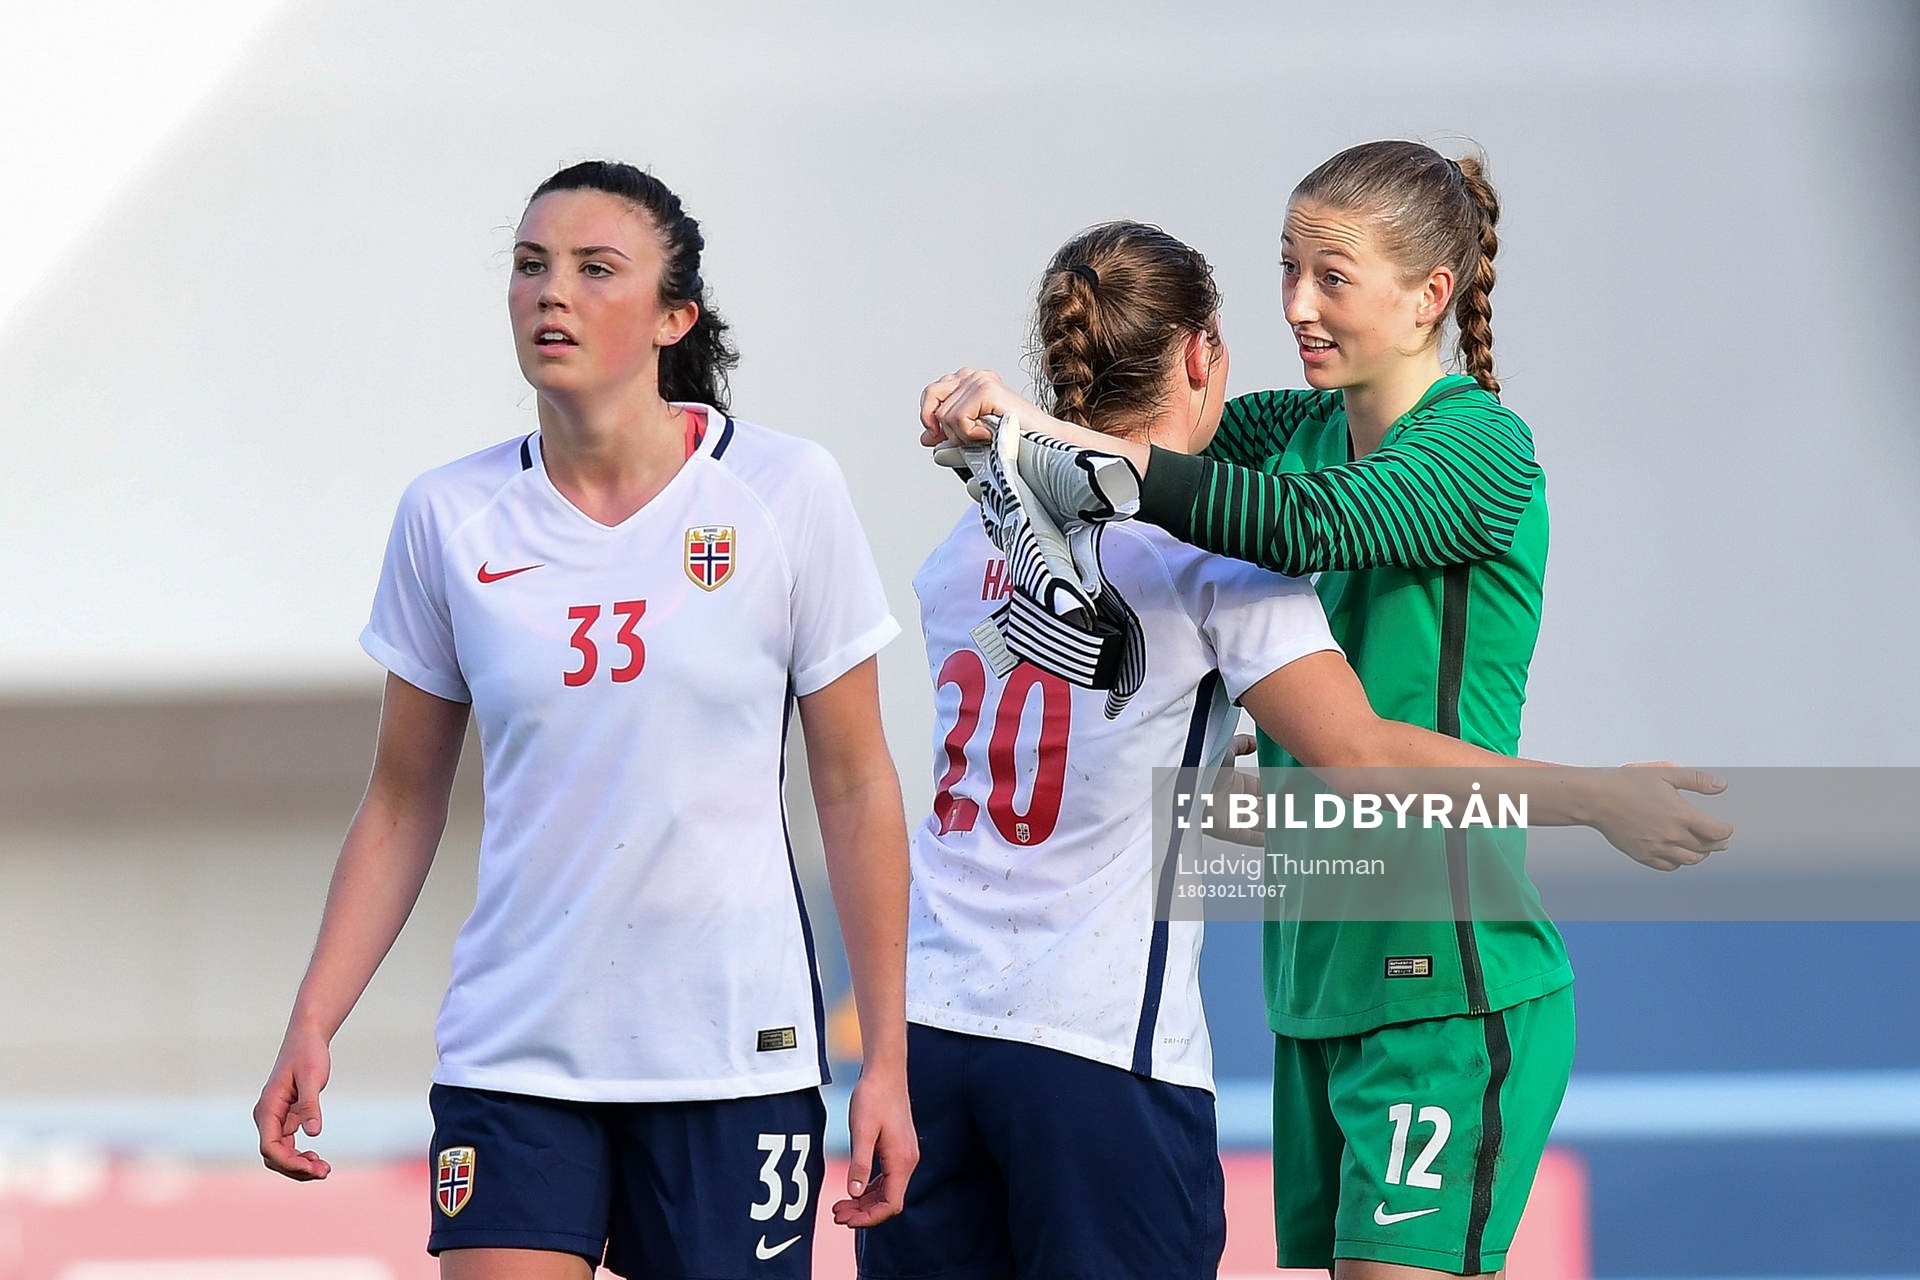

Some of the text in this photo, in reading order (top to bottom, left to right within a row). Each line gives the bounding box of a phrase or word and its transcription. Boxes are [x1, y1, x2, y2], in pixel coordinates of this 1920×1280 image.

[564, 599, 647, 688] 33
[933, 649, 1072, 847] 20
[749, 1133, 811, 1221] 33
[1385, 1103, 1452, 1189] 12
